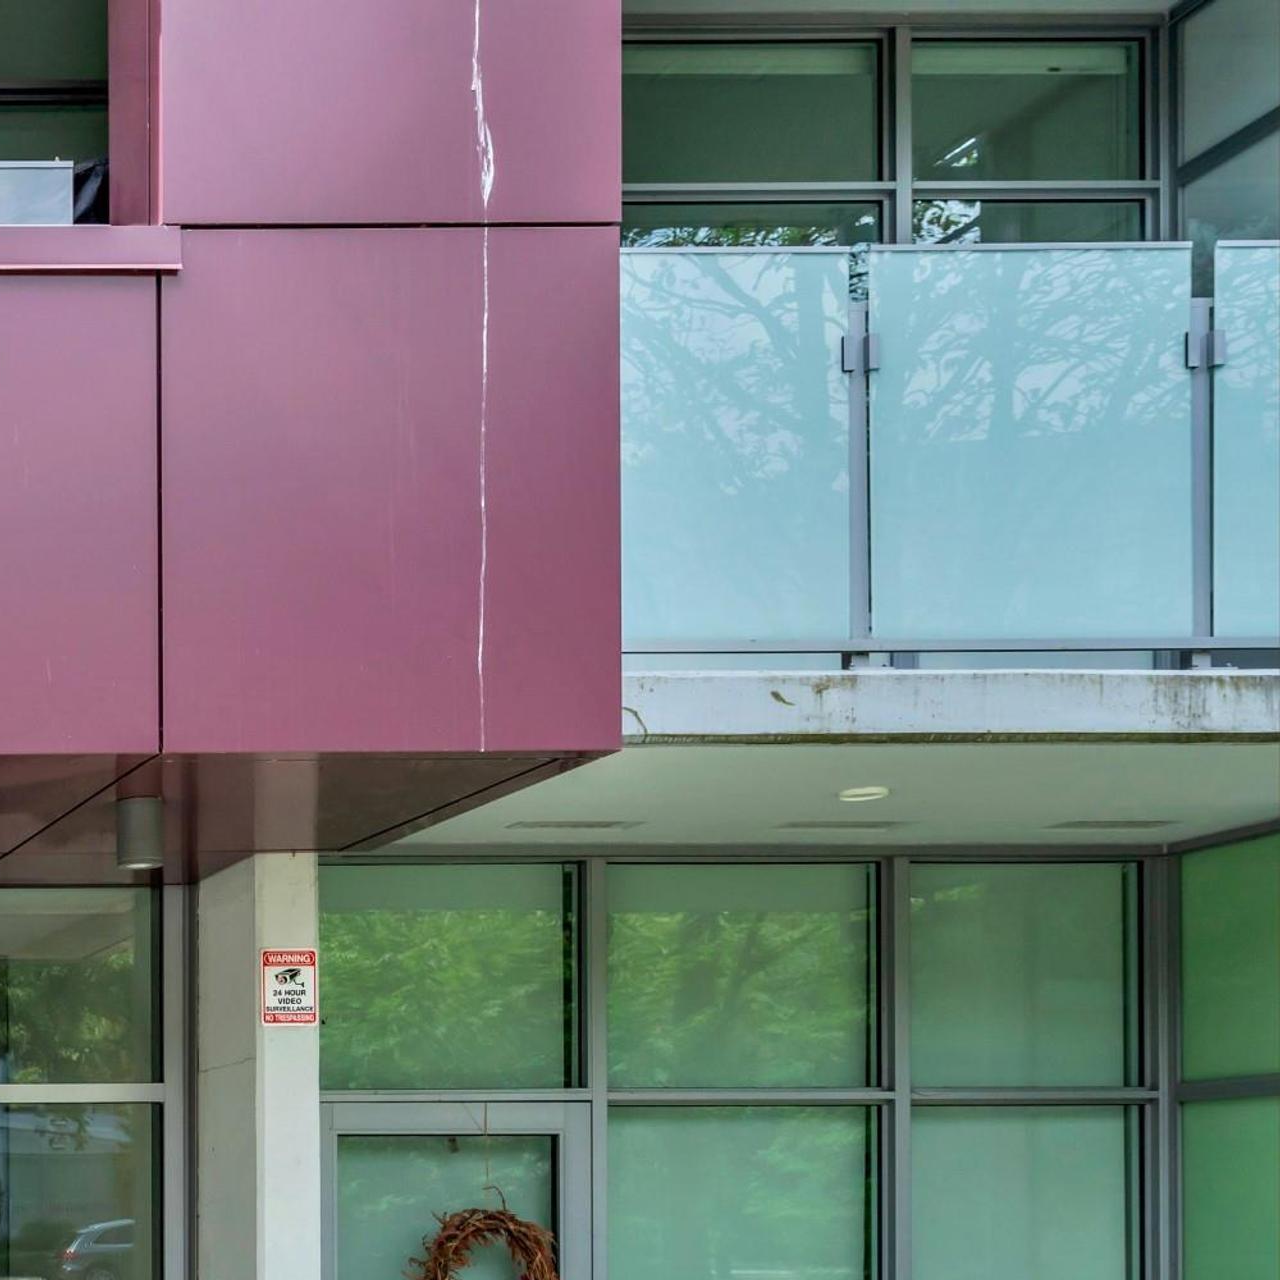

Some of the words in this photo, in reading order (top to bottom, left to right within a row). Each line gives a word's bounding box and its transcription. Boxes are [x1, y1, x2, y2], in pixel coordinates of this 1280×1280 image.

[268, 954, 311, 963] WARNING
[273, 989, 282, 997] 24
[277, 997, 303, 1005] VIDEO
